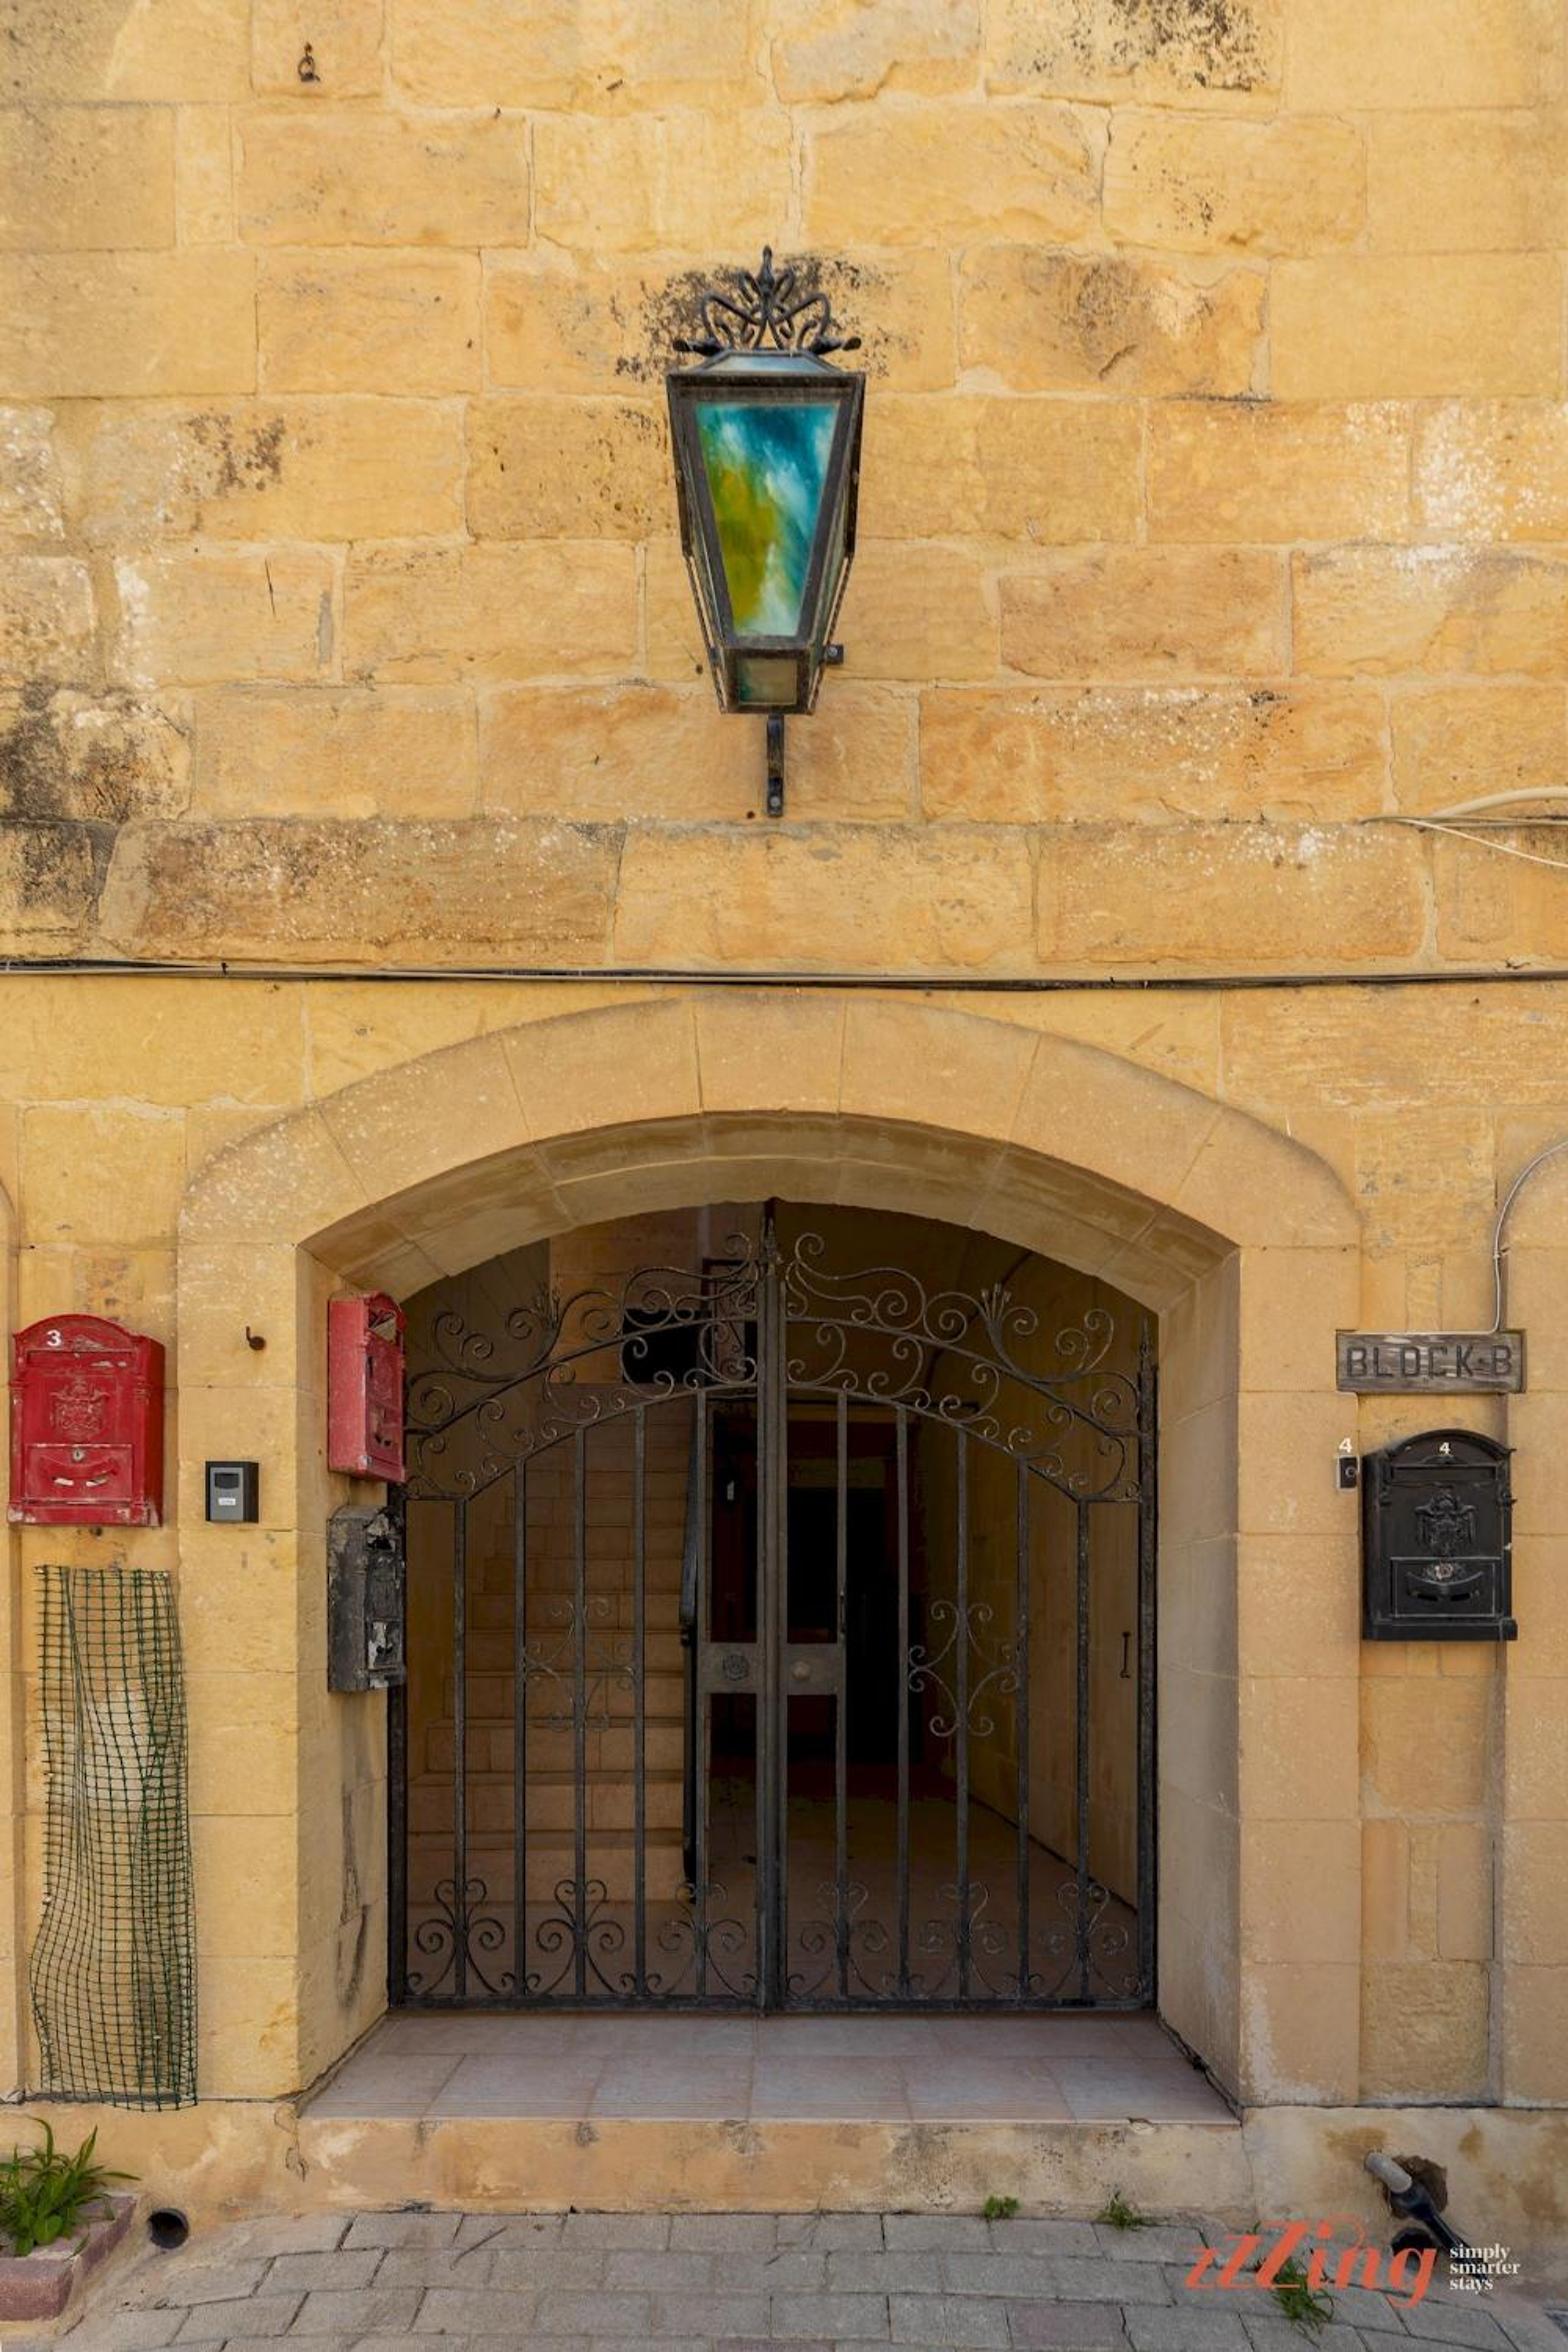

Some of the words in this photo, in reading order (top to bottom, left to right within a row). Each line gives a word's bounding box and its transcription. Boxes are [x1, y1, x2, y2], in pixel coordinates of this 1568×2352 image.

[47, 1329, 62, 1347] 3
[1338, 1437, 1353, 1454] 4
[1438, 1441, 1452, 1455] 4
